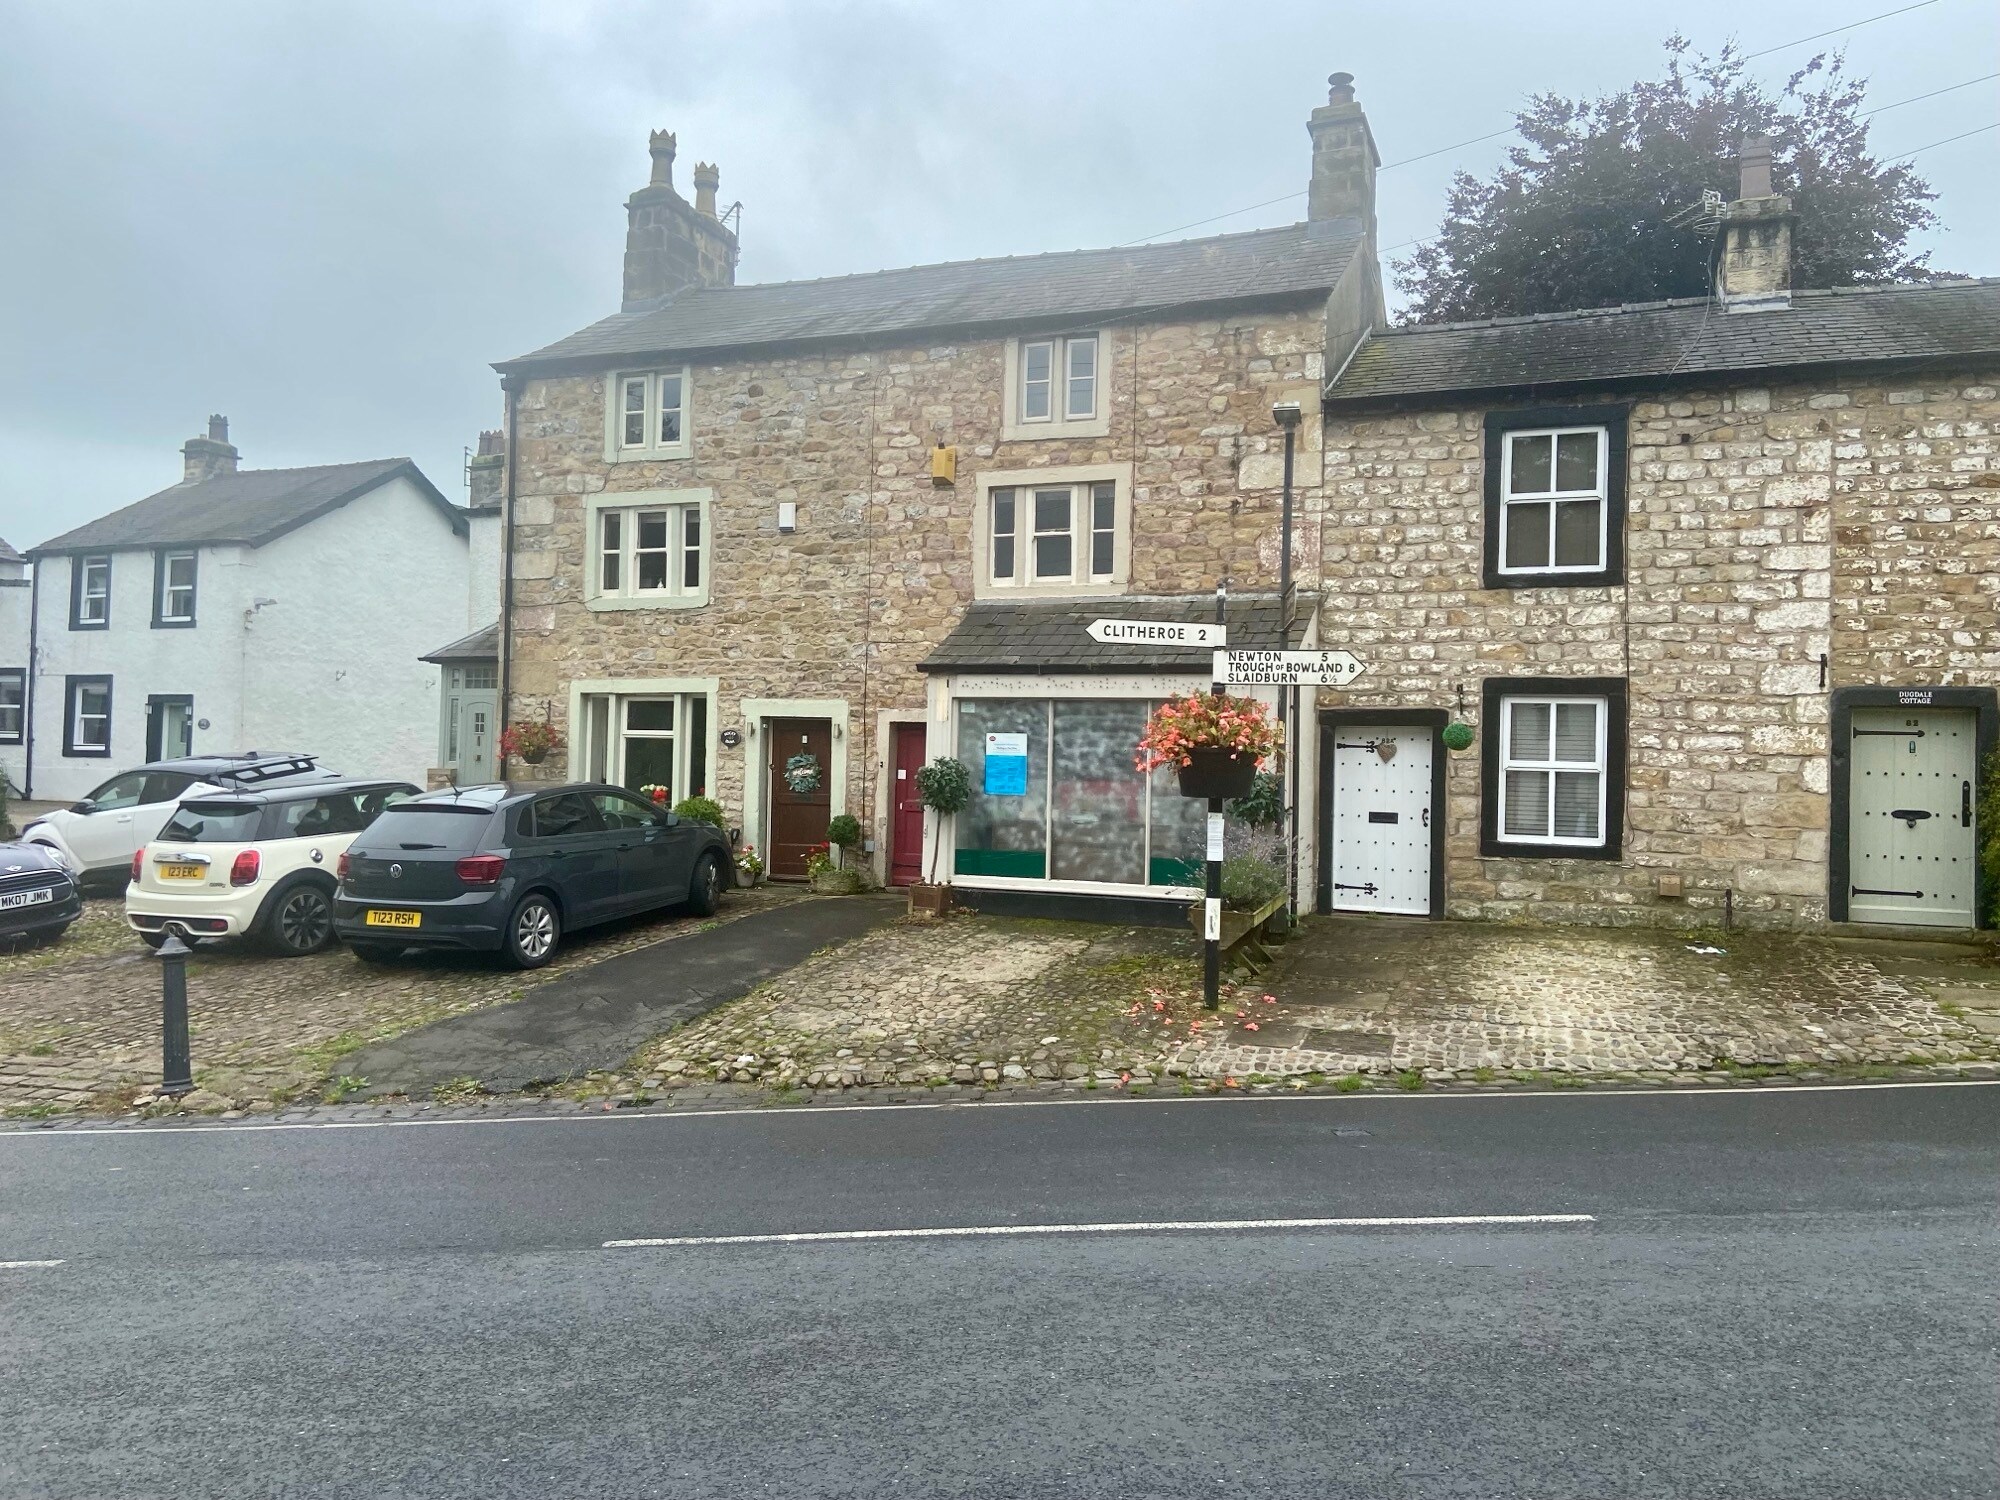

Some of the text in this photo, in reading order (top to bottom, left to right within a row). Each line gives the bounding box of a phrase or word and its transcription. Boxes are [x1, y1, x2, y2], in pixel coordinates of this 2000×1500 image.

[1103, 624, 1207, 641] CLITHEROE 2
[1228, 651, 1328, 662] NEWTON 5
[1228, 662, 1273, 673] TROUGH
[1286, 663, 1343, 673] BOWLAND
[1348, 664, 1355, 673] 8
[1228, 673, 1298, 683] SLAIDBURN
[168, 866, 199, 878] 123 ERC
[1, 890, 49, 907] MK07 JMK
[373, 911, 415, 925] T123 RSH
